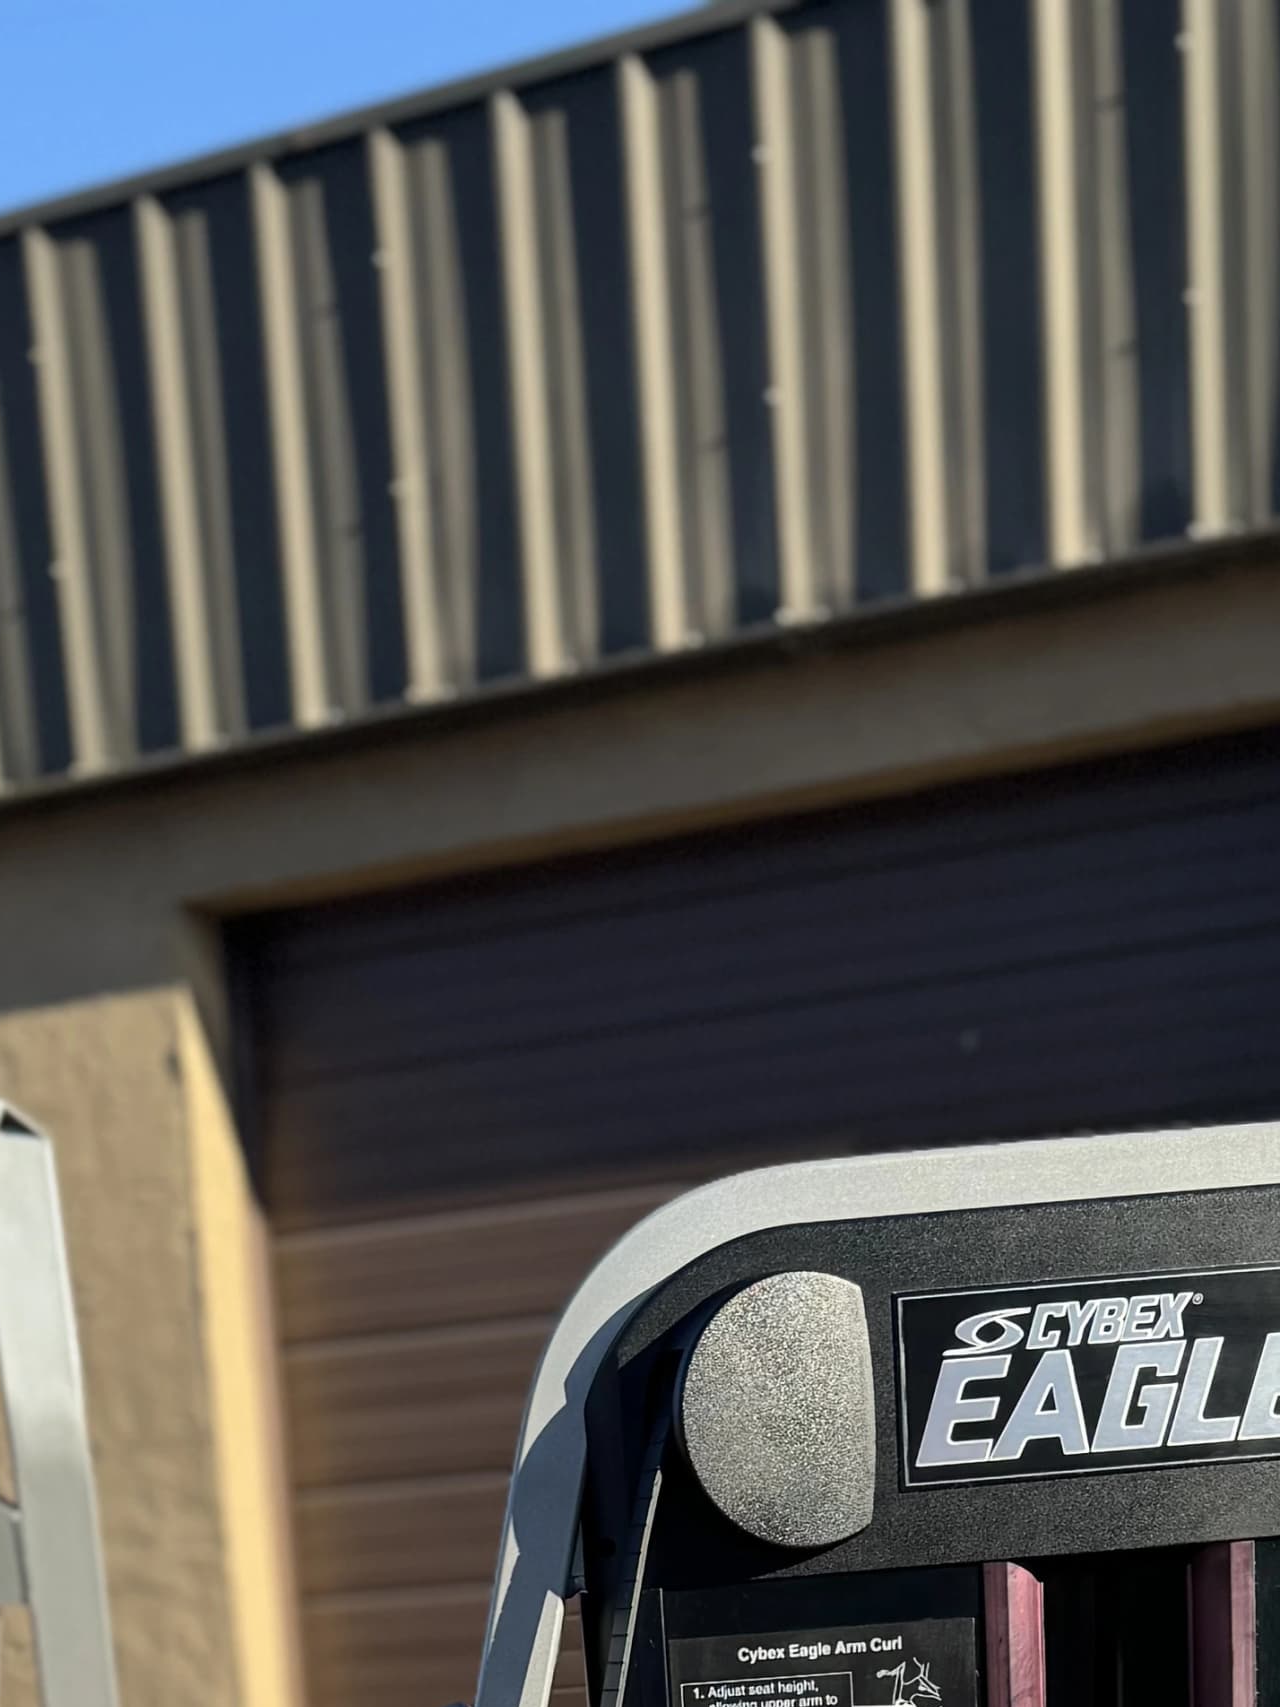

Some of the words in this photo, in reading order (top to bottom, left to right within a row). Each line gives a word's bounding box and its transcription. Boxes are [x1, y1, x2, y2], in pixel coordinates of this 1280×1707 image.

[738, 1648, 785, 1664] Cybex
[789, 1644, 831, 1660] Eagle
[835, 1640, 866, 1654] Arm
[870, 1636, 903, 1652] Curl
[693, 1687, 705, 1699] 1.
[708, 1684, 745, 1698] Adjust
[748, 1683, 774, 1695] seat
[778, 1680, 819, 1694] height,
[799, 1697, 823, 1707] arm
[826, 1694, 837, 1705] to
